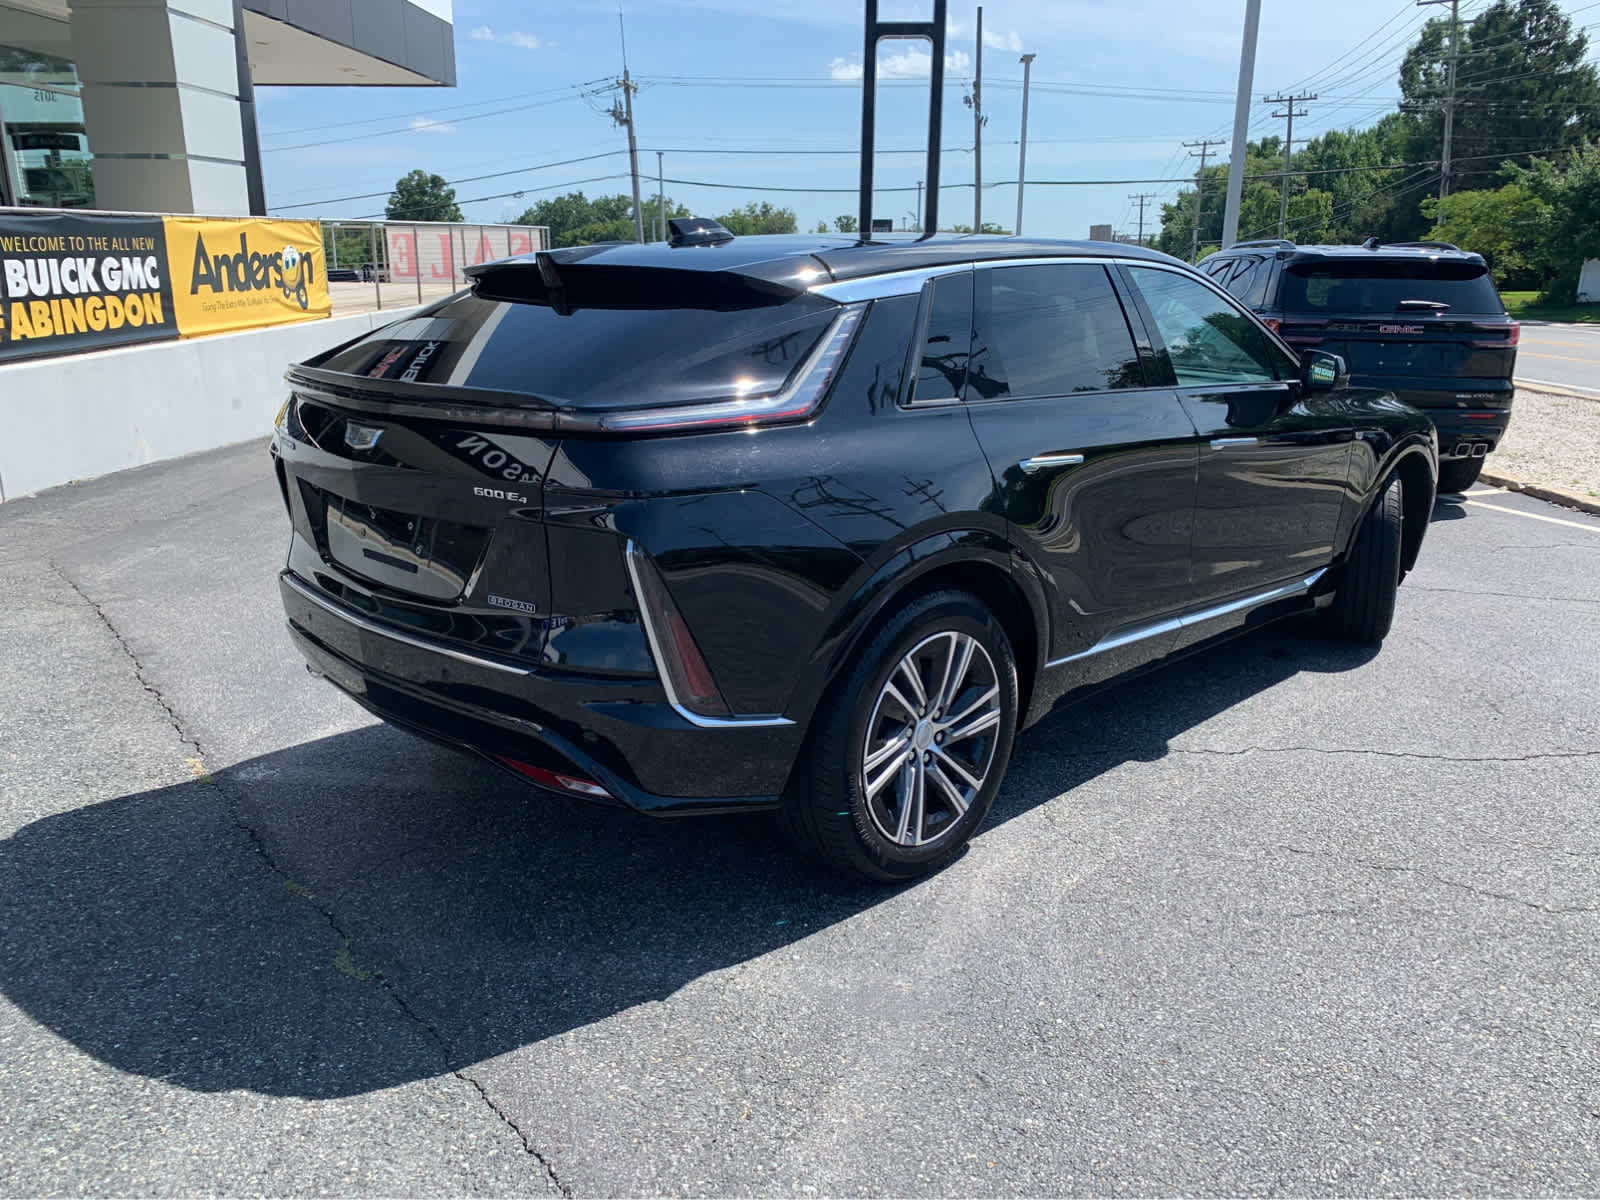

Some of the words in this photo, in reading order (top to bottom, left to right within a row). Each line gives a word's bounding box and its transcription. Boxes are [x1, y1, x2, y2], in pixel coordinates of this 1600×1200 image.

[0, 236, 66, 252] WELCOME
[68, 236, 85, 250] TO
[87, 236, 109, 251] THE
[112, 237, 129, 251] ALL
[132, 237, 155, 250] NEW
[190, 231, 314, 295] Anderson
[3, 256, 100, 298] BUICK
[100, 255, 160, 292] GMC
[10, 292, 165, 341] ABINGDON
[489, 596, 535, 612] BROGAN
